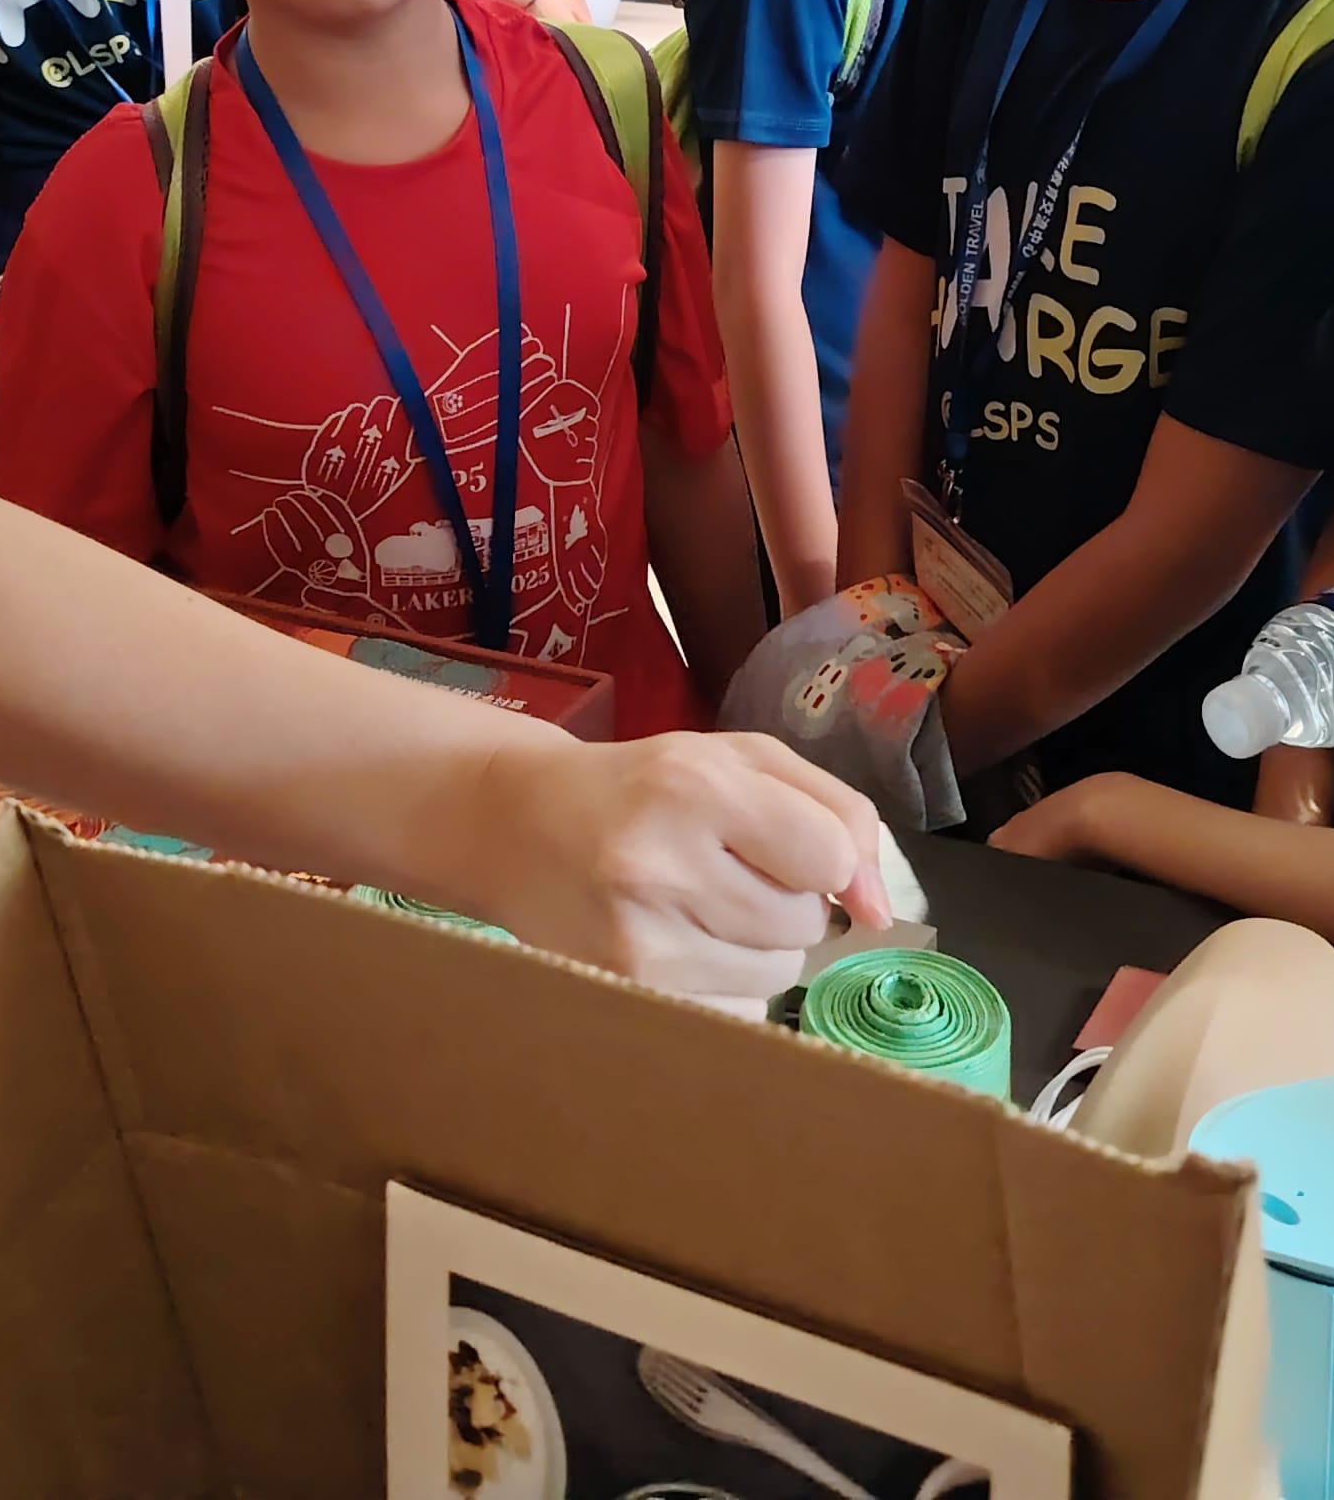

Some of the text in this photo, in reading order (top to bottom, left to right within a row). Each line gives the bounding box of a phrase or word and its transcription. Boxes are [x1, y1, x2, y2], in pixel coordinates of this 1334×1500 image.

[40, 31, 143, 88] @LSP
[965, 200, 985, 257] TRAVEL
[390, 562, 551, 612] LAKER 025
